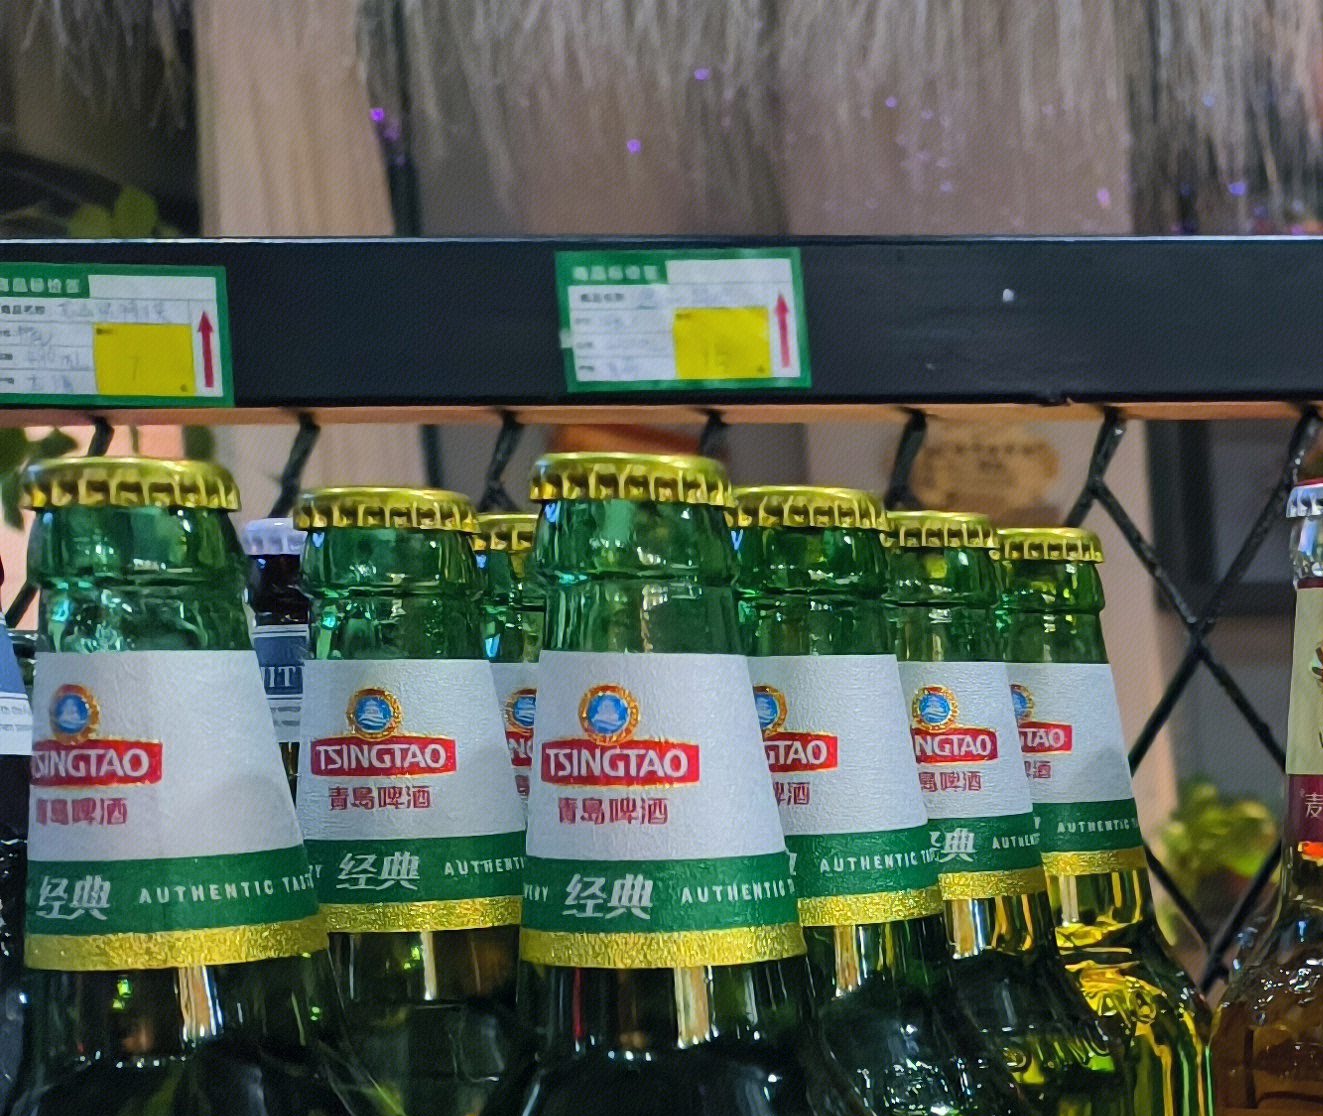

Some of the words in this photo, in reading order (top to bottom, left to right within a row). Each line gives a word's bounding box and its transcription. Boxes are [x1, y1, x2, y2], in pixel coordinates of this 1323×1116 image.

[315, 745, 447, 770] TSINGTAO
[545, 748, 688, 778] TSINGTAO
[336, 851, 421, 891] 经典
[819, 851, 919, 875] AUTHENTIC
[36, 875, 111, 920] 经典
[139, 879, 273, 904] AUTHENTIC
[561, 873, 654, 921] 经典
